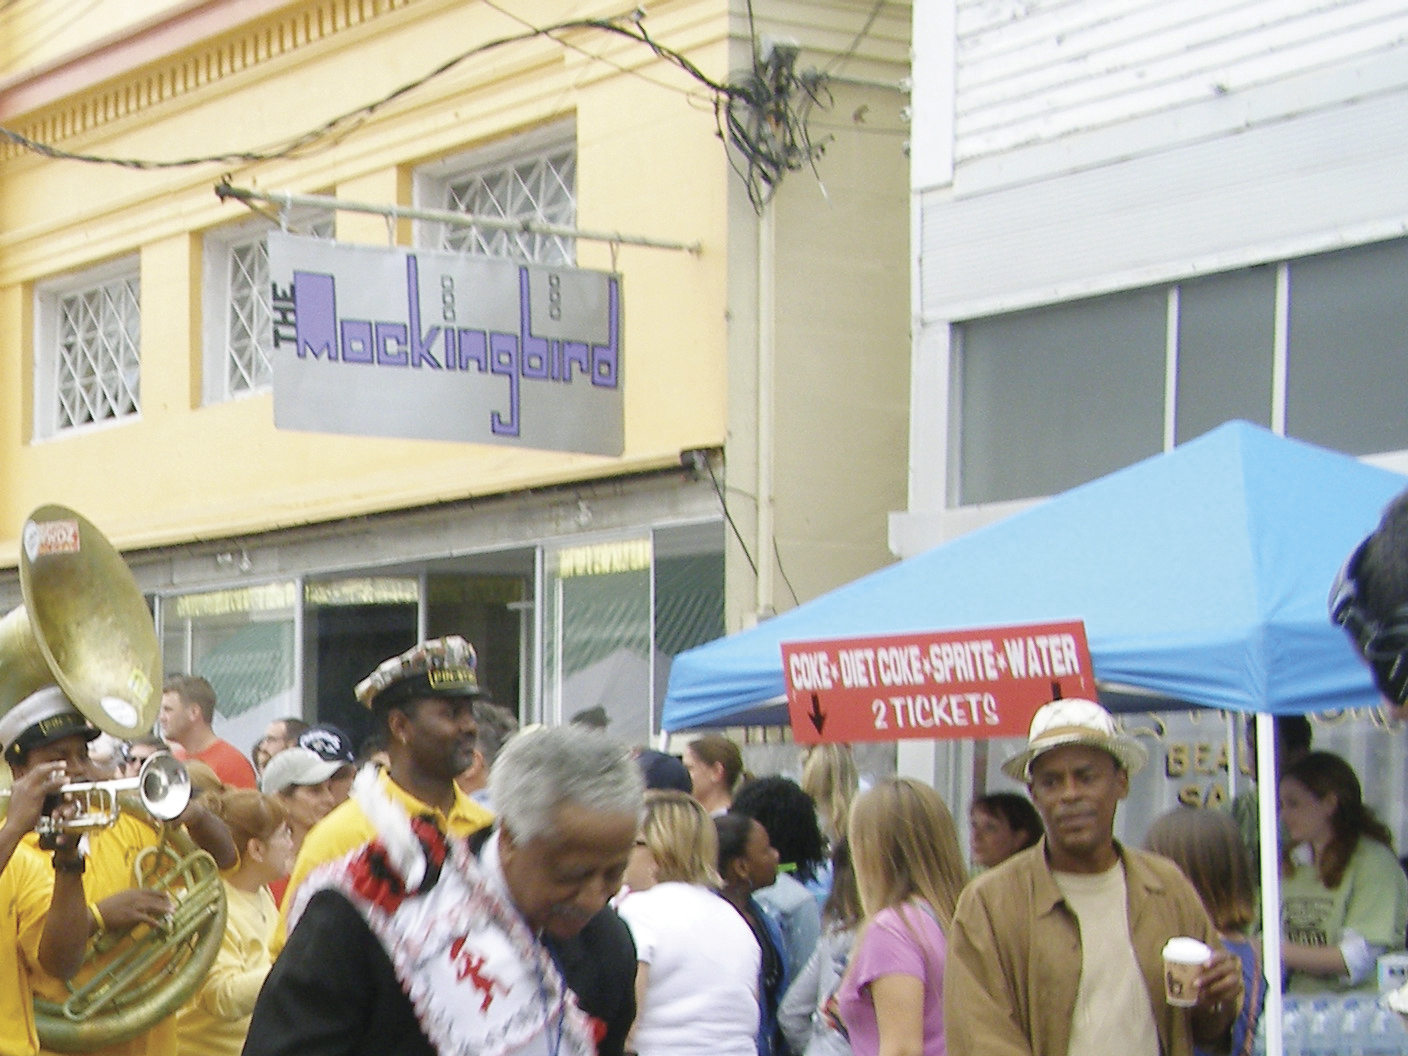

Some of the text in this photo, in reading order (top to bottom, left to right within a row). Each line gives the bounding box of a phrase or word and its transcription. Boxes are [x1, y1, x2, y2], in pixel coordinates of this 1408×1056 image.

[272, 281, 297, 350] THE
[293, 253, 619, 437] Mockingbird
[789, 633, 1081, 690] COKE DIET COKE SPRITE WATER
[871, 692, 1001, 730] 2 TICKETS
